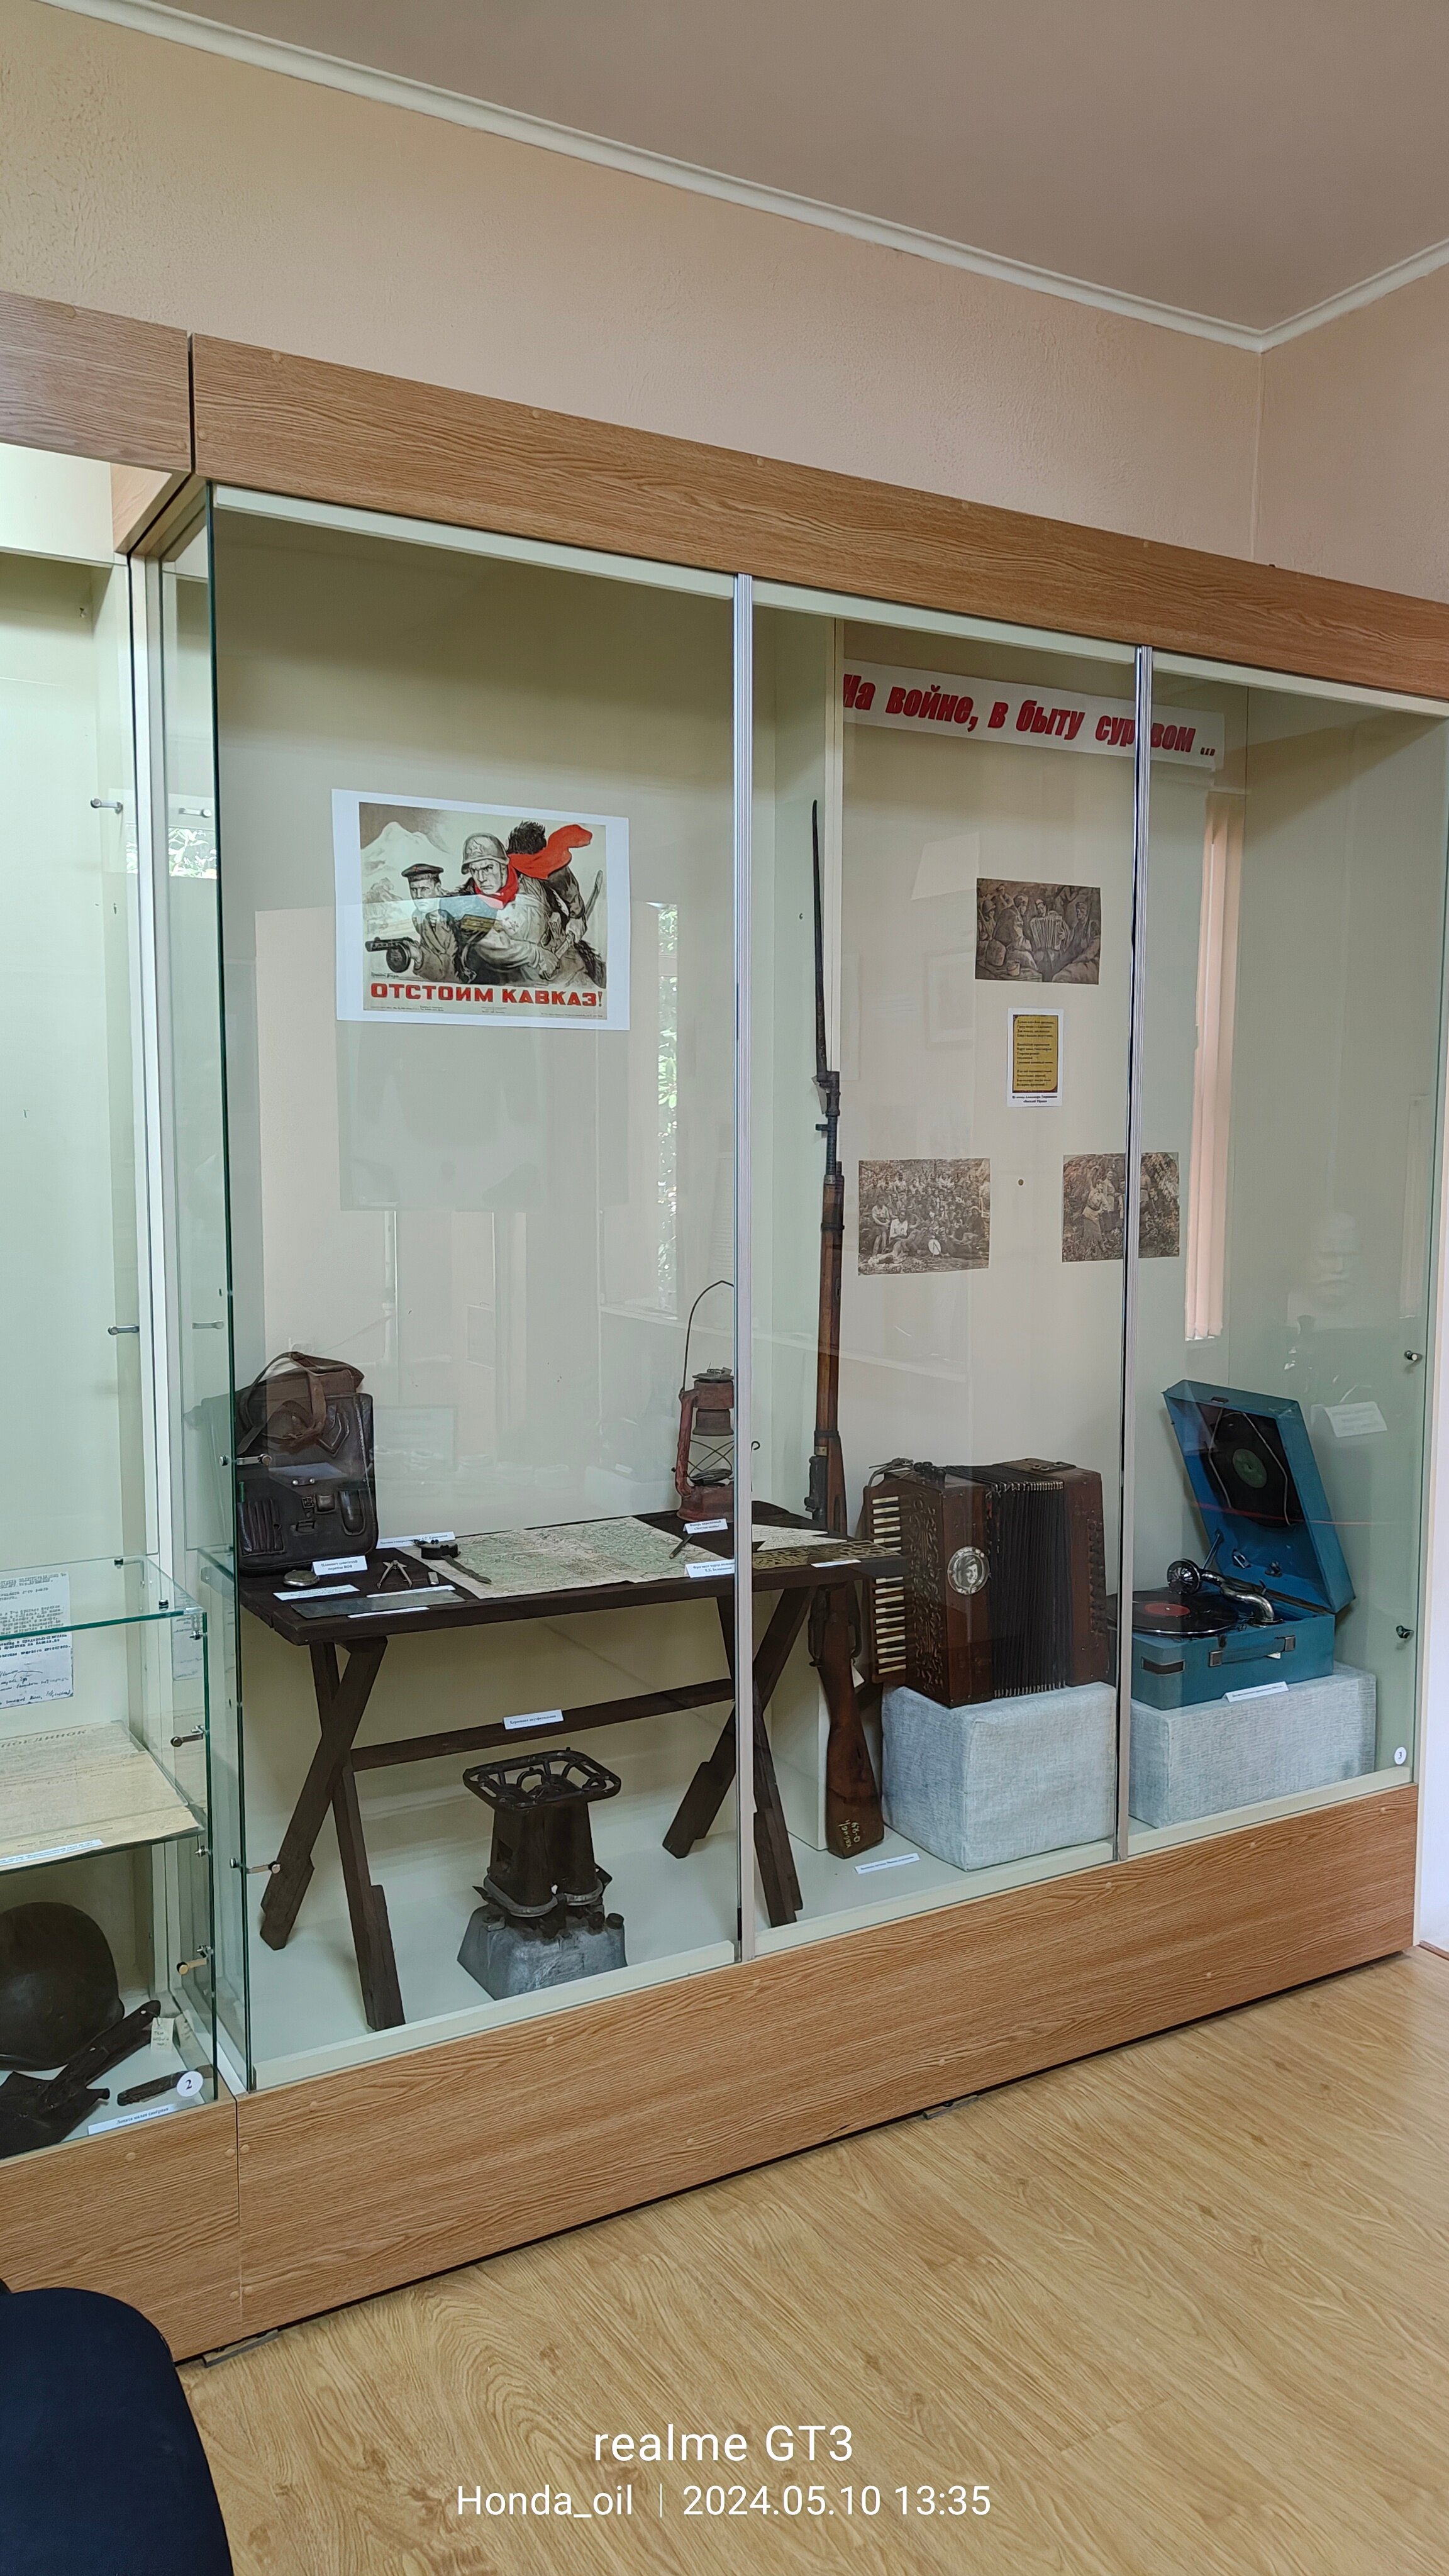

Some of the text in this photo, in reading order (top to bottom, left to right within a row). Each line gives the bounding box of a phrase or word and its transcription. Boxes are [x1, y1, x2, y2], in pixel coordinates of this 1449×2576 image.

[843, 674, 876, 710] На
[886, 684, 979, 733] войне,
[988, 701, 1009, 730] в
[1016, 700, 1085, 741] быту
[1095, 715, 1196, 753] сурвом
[370, 982, 602, 1008] ОТСТОИМ КАВКАЗ!
[185, 2079, 192, 2090] 2
